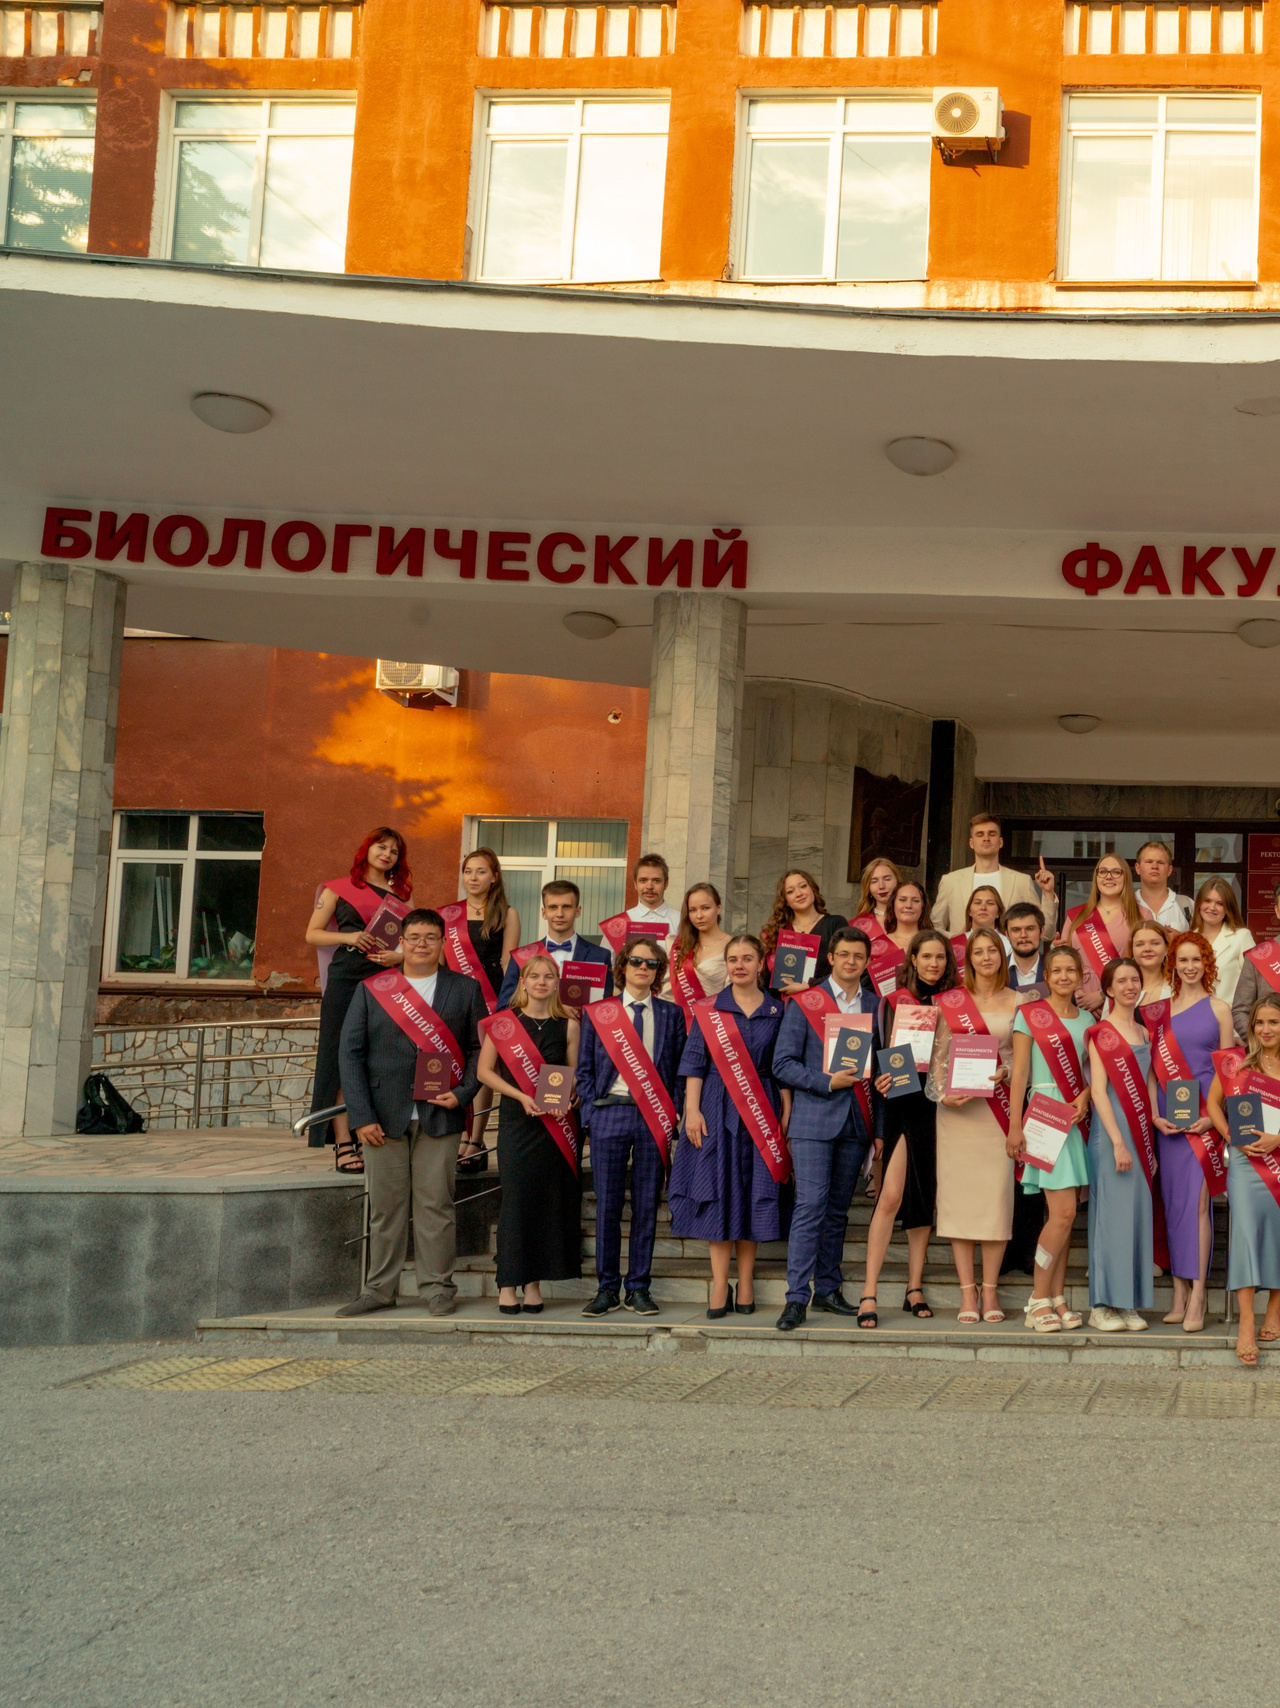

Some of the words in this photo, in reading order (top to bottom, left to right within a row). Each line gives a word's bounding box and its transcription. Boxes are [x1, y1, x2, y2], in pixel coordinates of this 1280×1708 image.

[40, 506, 748, 589] БИОЛОГИЧЕСКИЙ
[448, 926, 474, 975] ЛУЧШИЙ
[1084, 923, 1112, 966] ЛУЧШИЙ
[391, 991, 435, 1036] ЛУЧШИЙ
[958, 1013, 978, 1036] ЛУЧ
[510, 1043, 540, 1087] ЛУЧШИ
[612, 1028, 648, 1081] ЛУЧШИЙ
[1047, 1033, 1078, 1088] ЛУЧШИЙ
[1158, 1024, 1180, 1076] ЛУЧШИЙ
[709, 1011, 739, 1062] ЛУЧШИЙ
[730, 1062, 772, 1138] ВЫПУСКНИК
[766, 1137, 783, 1164] 2024
[1114, 1057, 1144, 1113] ЛУЧШИЙ
[1032, 1106, 1067, 1126] БЛАГОДАРНОСТЬ
[1208, 1151, 1224, 1177] 2024
